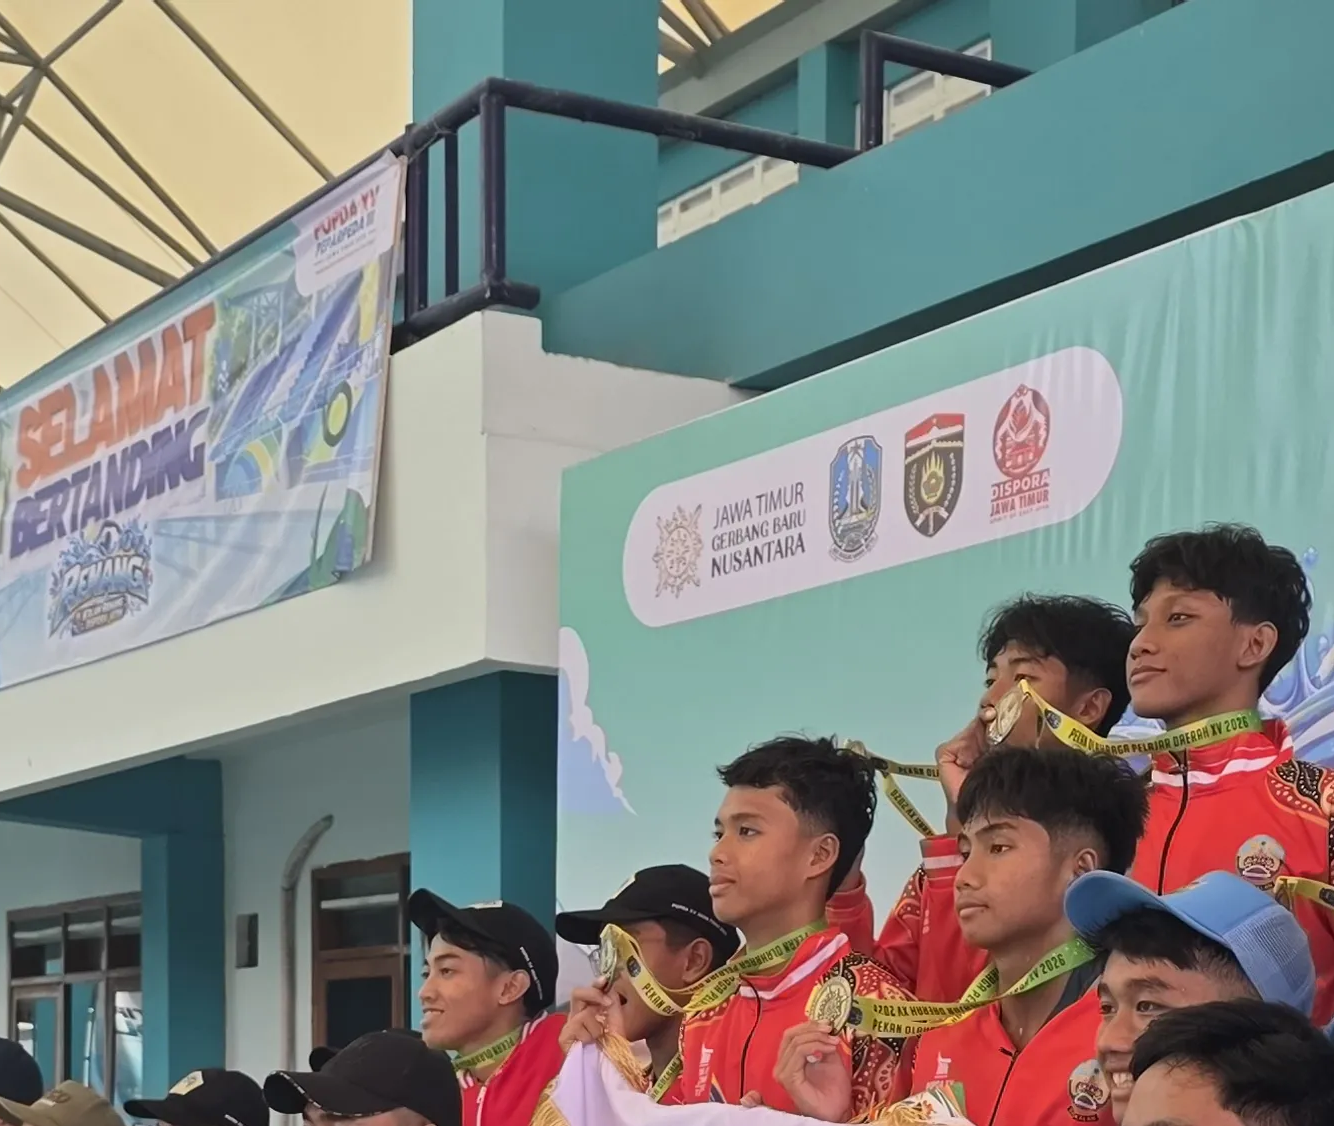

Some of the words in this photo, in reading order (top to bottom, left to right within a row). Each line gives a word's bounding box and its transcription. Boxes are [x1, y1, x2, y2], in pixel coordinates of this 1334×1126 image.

[16, 302, 218, 490] SELAMAT
[10, 406, 211, 561] BERTANDING
[991, 471, 1049, 499] DISPORA
[713, 492, 753, 530] JAWA
[755, 481, 805, 516] TIMUR
[990, 498, 1015, 517] JAWA
[1019, 489, 1049, 509] TIMUR
[711, 518, 769, 551] GERBANG
[772, 508, 807, 534] BARU
[711, 532, 806, 578] NUSANTARA
[1173, 728, 1209, 747] DAERAH
[1210, 723, 1222, 735] XV
[1225, 716, 1249, 732] 2026
[1041, 953, 1066, 975] 2026
[642, 983, 664, 1007] PEKAN
[872, 1018, 902, 1034] PEKAN
